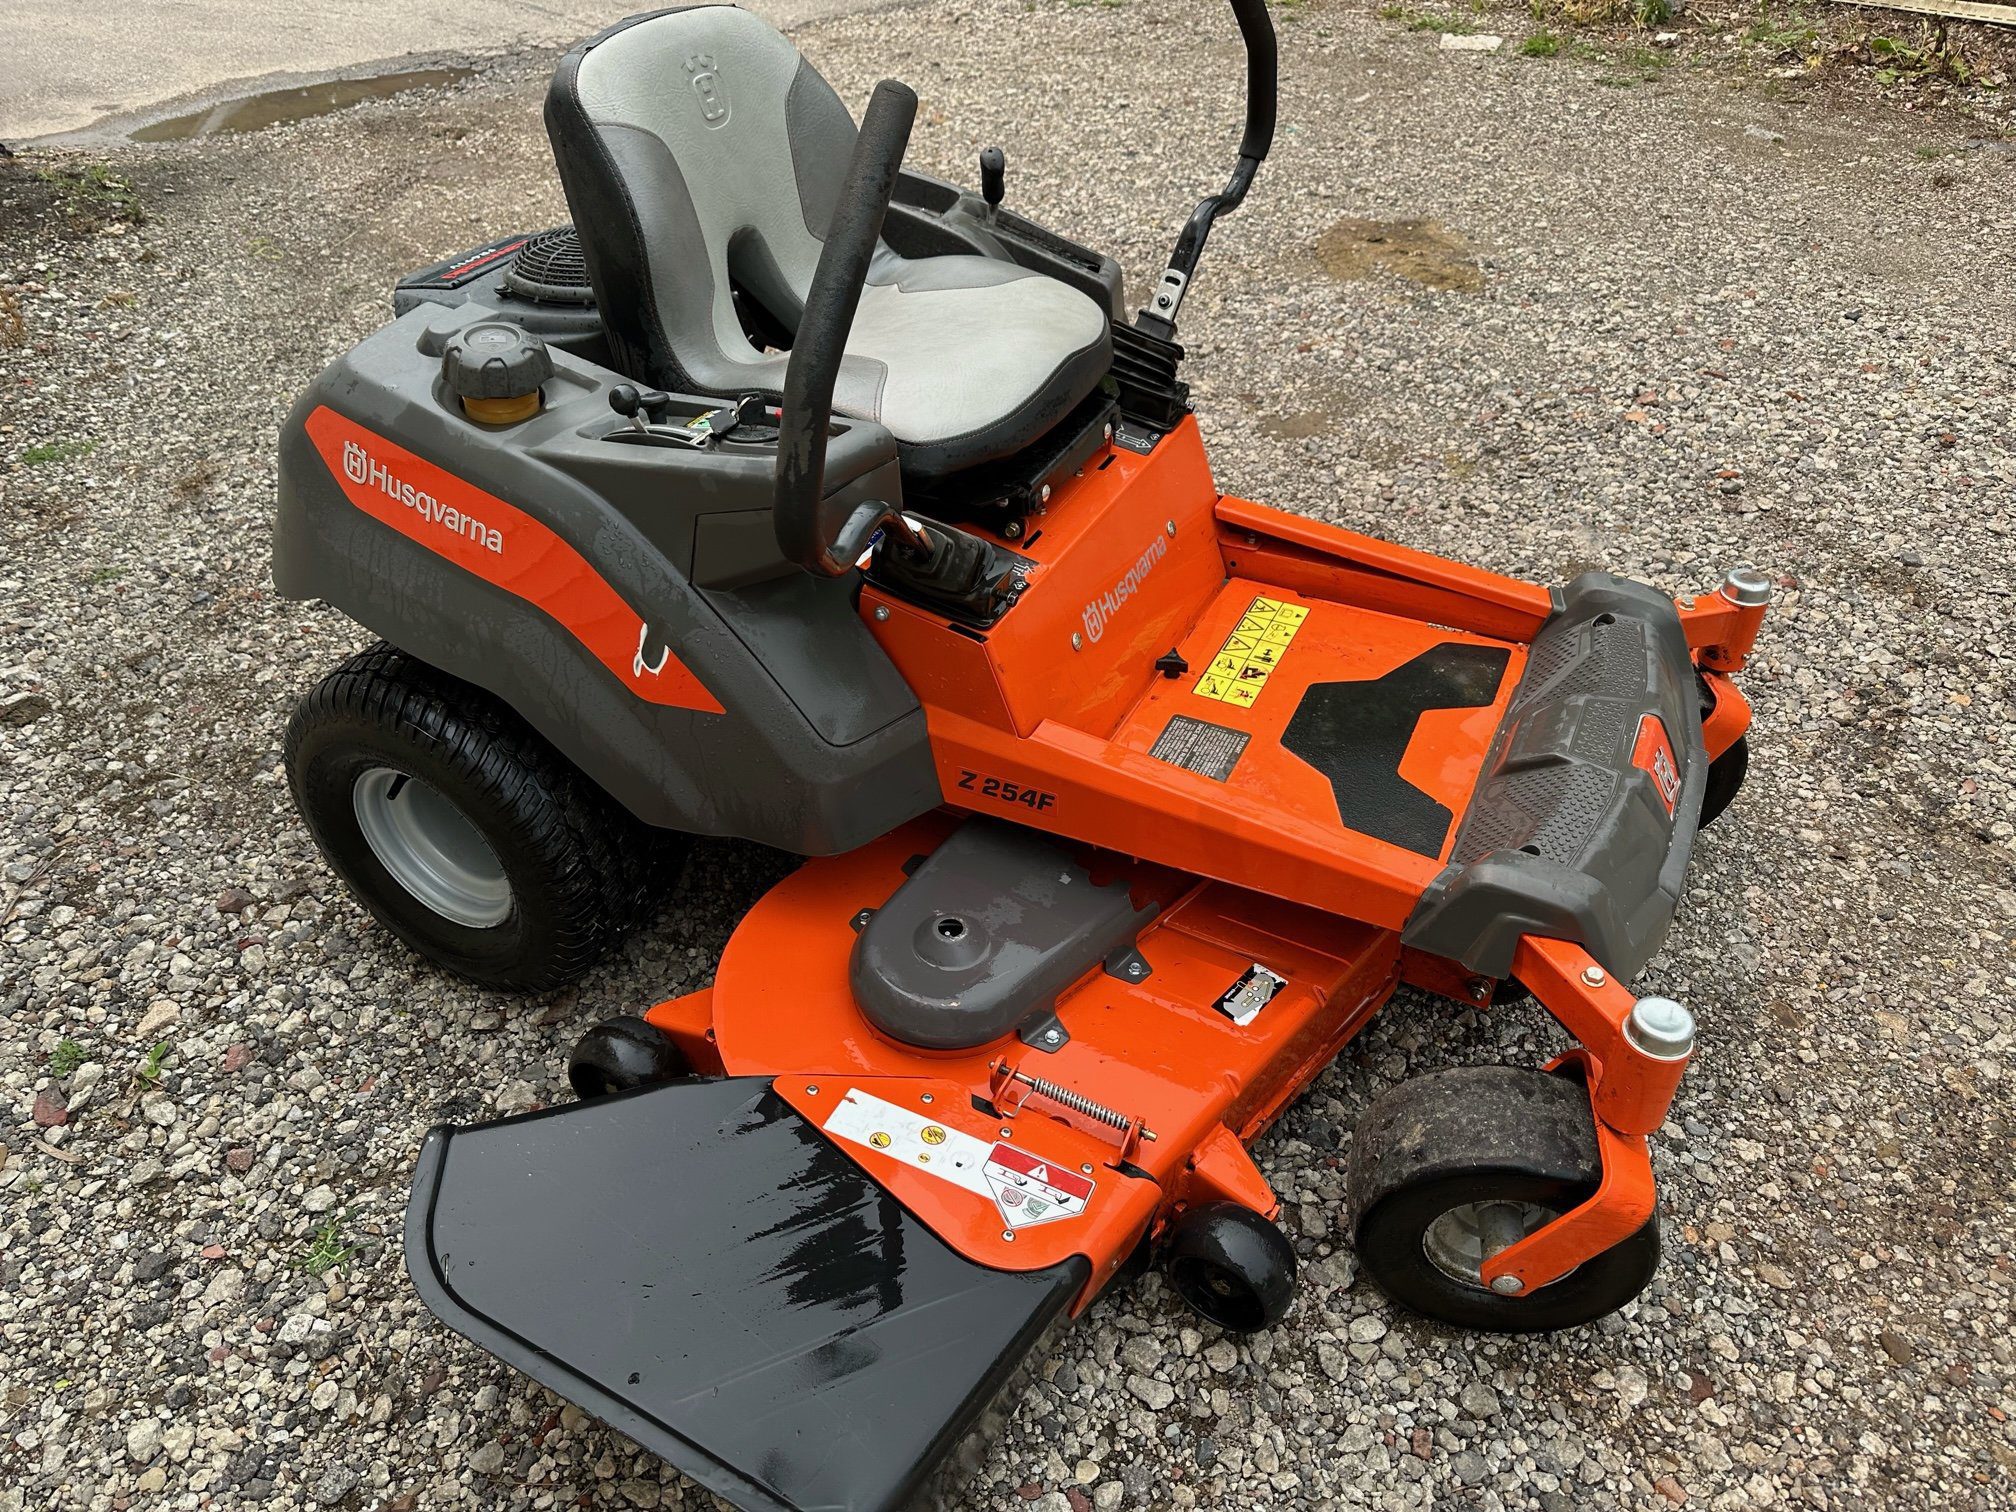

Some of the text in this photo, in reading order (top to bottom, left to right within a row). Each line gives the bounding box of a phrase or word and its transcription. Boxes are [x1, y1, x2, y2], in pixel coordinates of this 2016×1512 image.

[368, 458, 503, 554] Husqvarna
[1097, 534, 1167, 625] Husqvarna
[958, 770, 1056, 811] Z 254F
